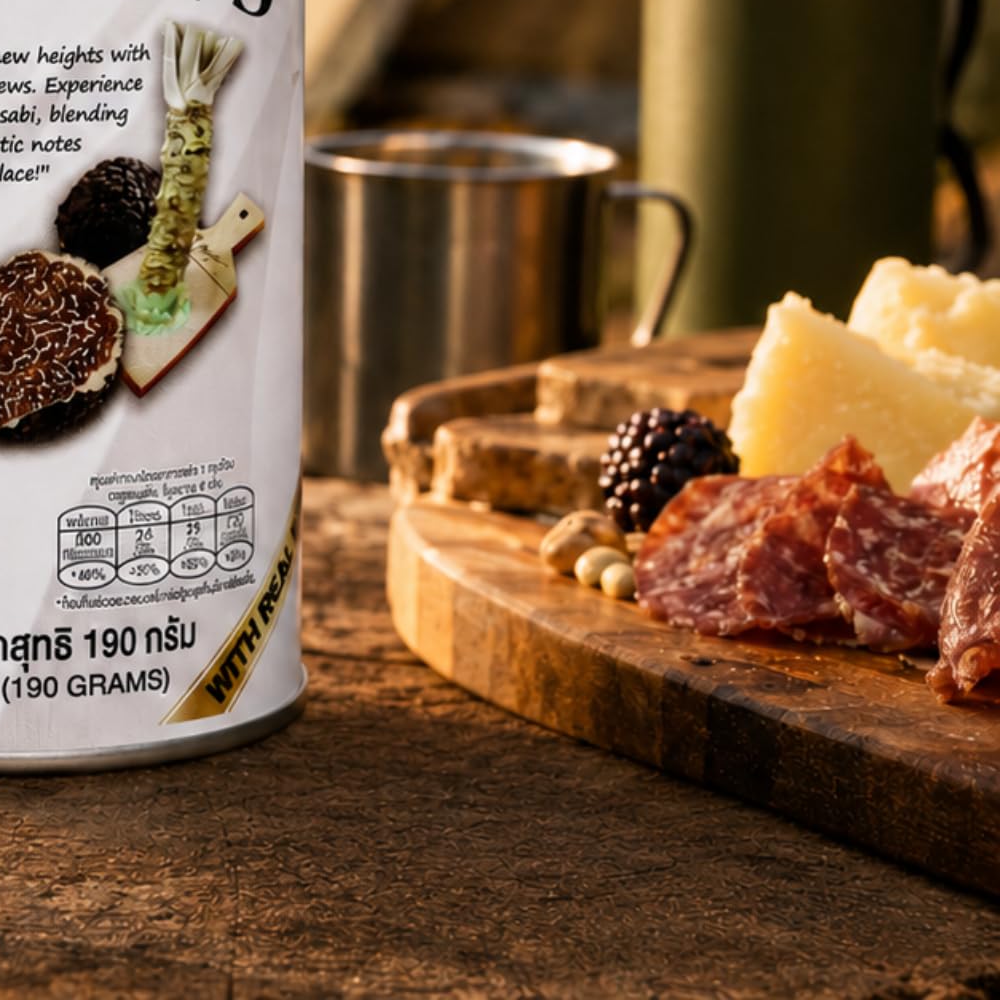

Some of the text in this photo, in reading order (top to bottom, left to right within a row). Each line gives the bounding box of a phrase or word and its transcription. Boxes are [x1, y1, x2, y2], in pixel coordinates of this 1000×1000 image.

[37, 45, 104, 70] heights
[111, 43, 151, 62] with
[44, 74, 143, 100] Experience
[49, 103, 129, 127] blending
[31, 135, 82, 153] notes
[84, 626, 136, 658] 190
[145, 615, 196, 654] กรัม
[205, 616, 262, 705] WITH
[257, 545, 294, 626] REAL
[1, 675, 59, 704] (190
[67, 666, 170, 698] GRAMS)
